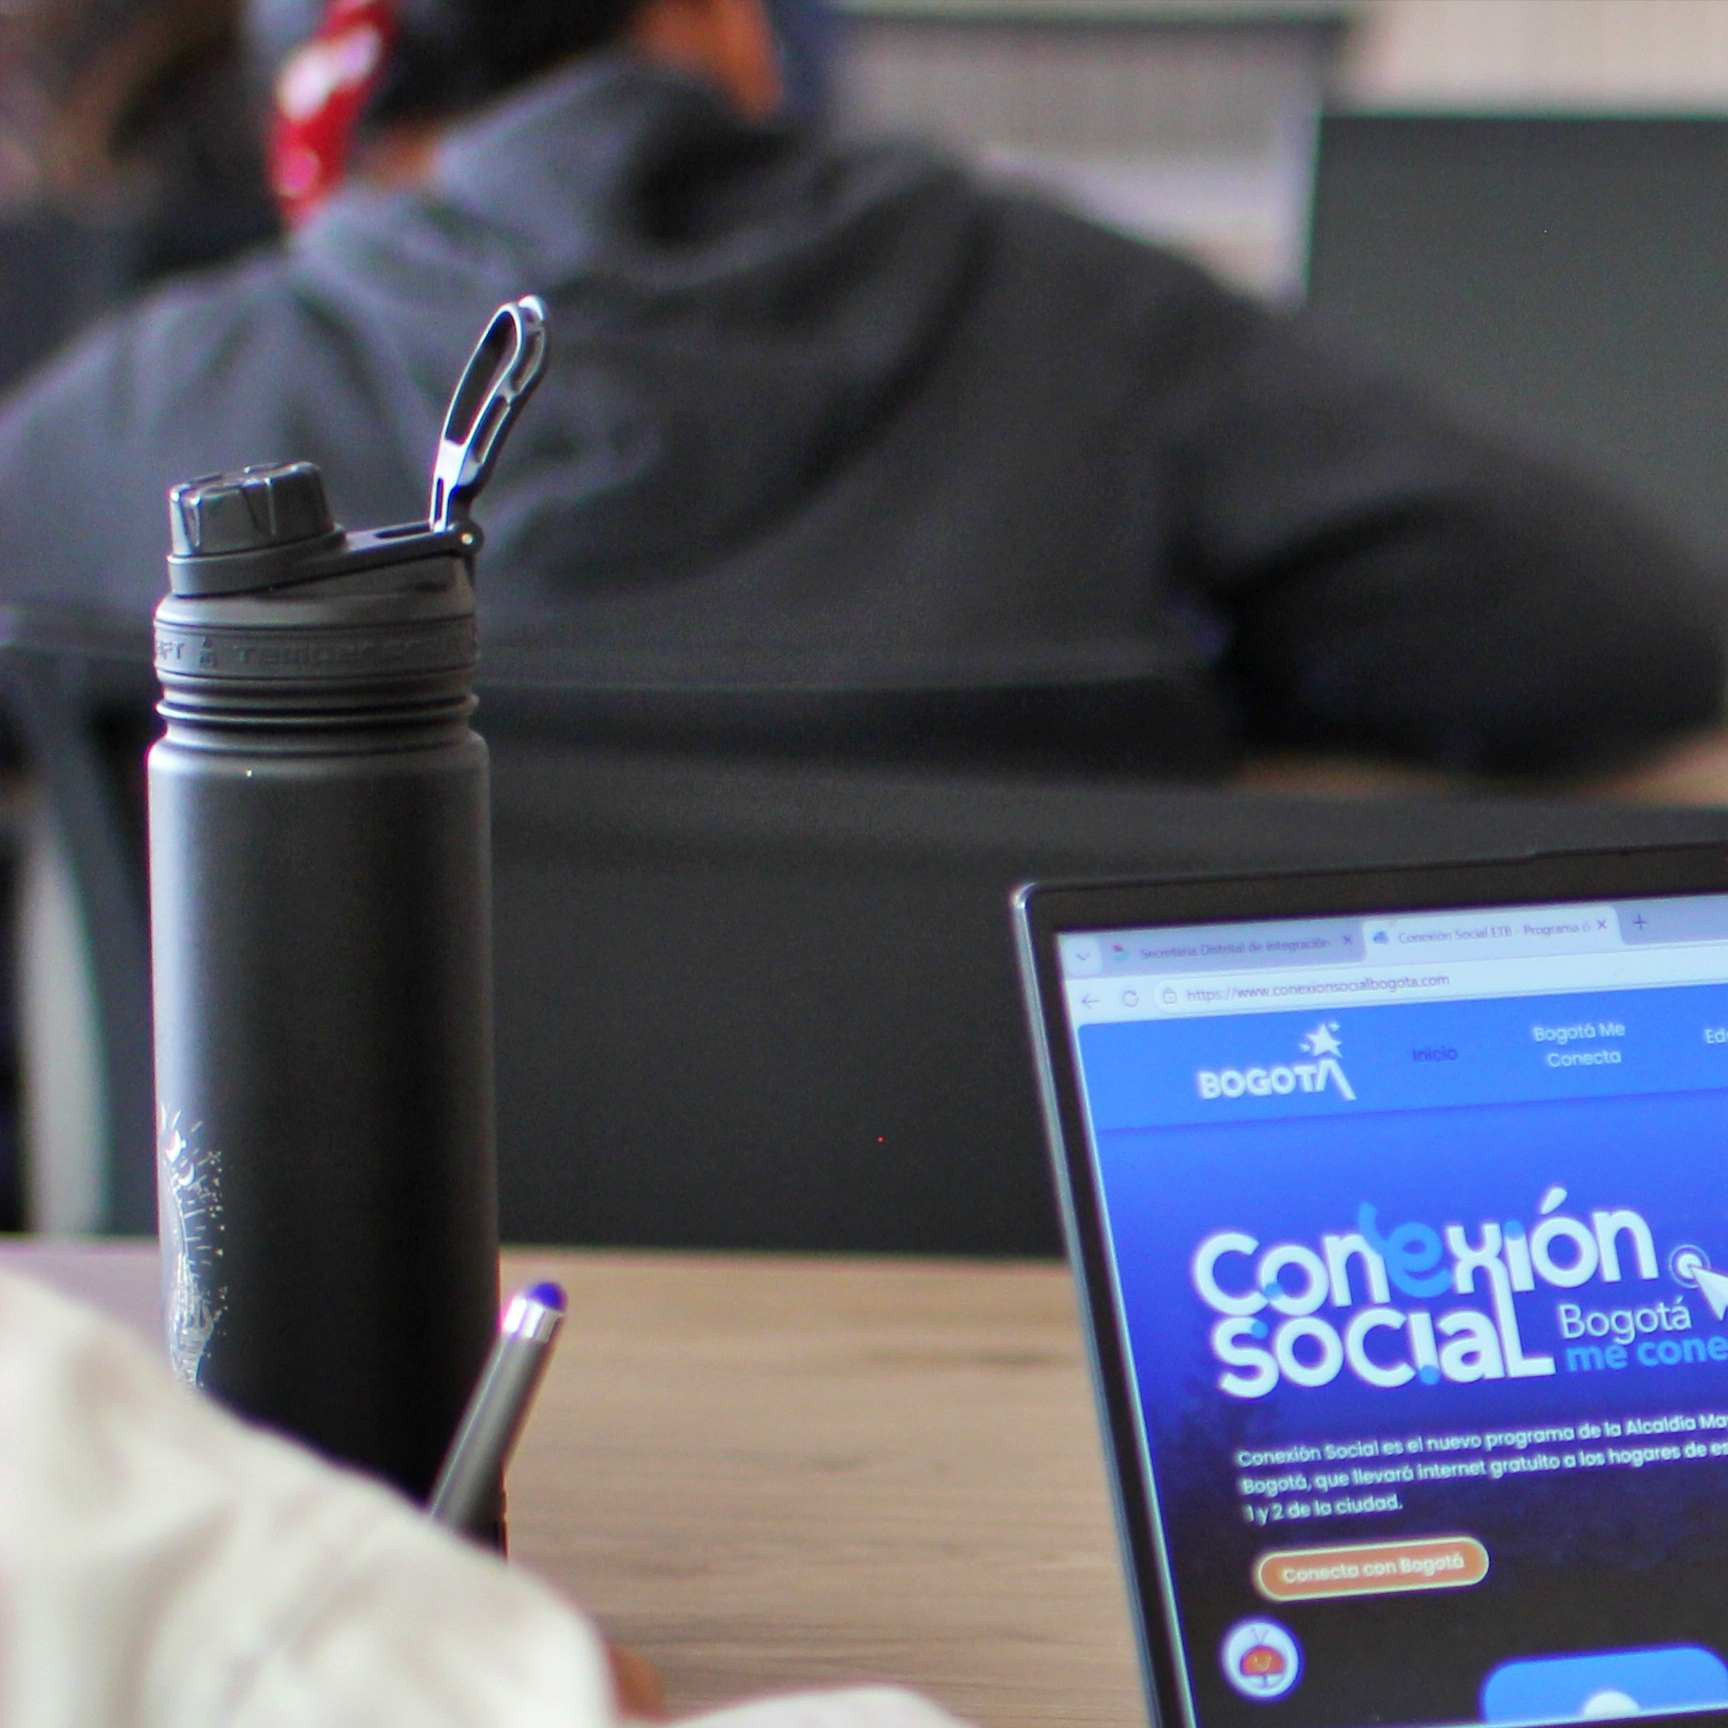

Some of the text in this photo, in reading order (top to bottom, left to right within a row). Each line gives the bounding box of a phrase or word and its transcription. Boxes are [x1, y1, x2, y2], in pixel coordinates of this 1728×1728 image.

[1455, 925, 1488, 940] Social
[1523, 922, 1579, 938] Programa
[1533, 1021, 1626, 1045] Bogotá Me
[1412, 1046, 1458, 1063] Inicio
[1547, 1048, 1622, 1068] Conecta
[1193, 1186, 1660, 1318] Conexión
[1557, 1295, 1693, 1344] Bogotá
[1565, 1337, 1628, 1373] me
[1237, 1445, 1322, 1468] Conexión
[1325, 1440, 1379, 1459] Social
[1383, 1440, 1405, 1455] es
[1407, 1436, 1424, 1453] el
[1426, 1434, 1482, 1451] nuevo
[1485, 1426, 1575, 1451] programa
[1578, 1423, 1601, 1441] de
[1604, 1420, 1621, 1437] la
[1242, 1473, 1312, 1498] Bogotá,
[1315, 1473, 1349, 1492] que
[1352, 1465, 1415, 1486] llevará
[1417, 1460, 1486, 1481] internet
[1489, 1455, 1561, 1479] gratuito
[1564, 1456, 1577, 1469] a
[1580, 1451, 1606, 1468] los
[1608, 1447, 1681, 1468] hogares
[1684, 1441, 1707, 1459] de
[1245, 1493, 1404, 1526] 1 y 2 de la ciudad.
[1282, 1552, 1465, 1584] Conecta con Bogotá
